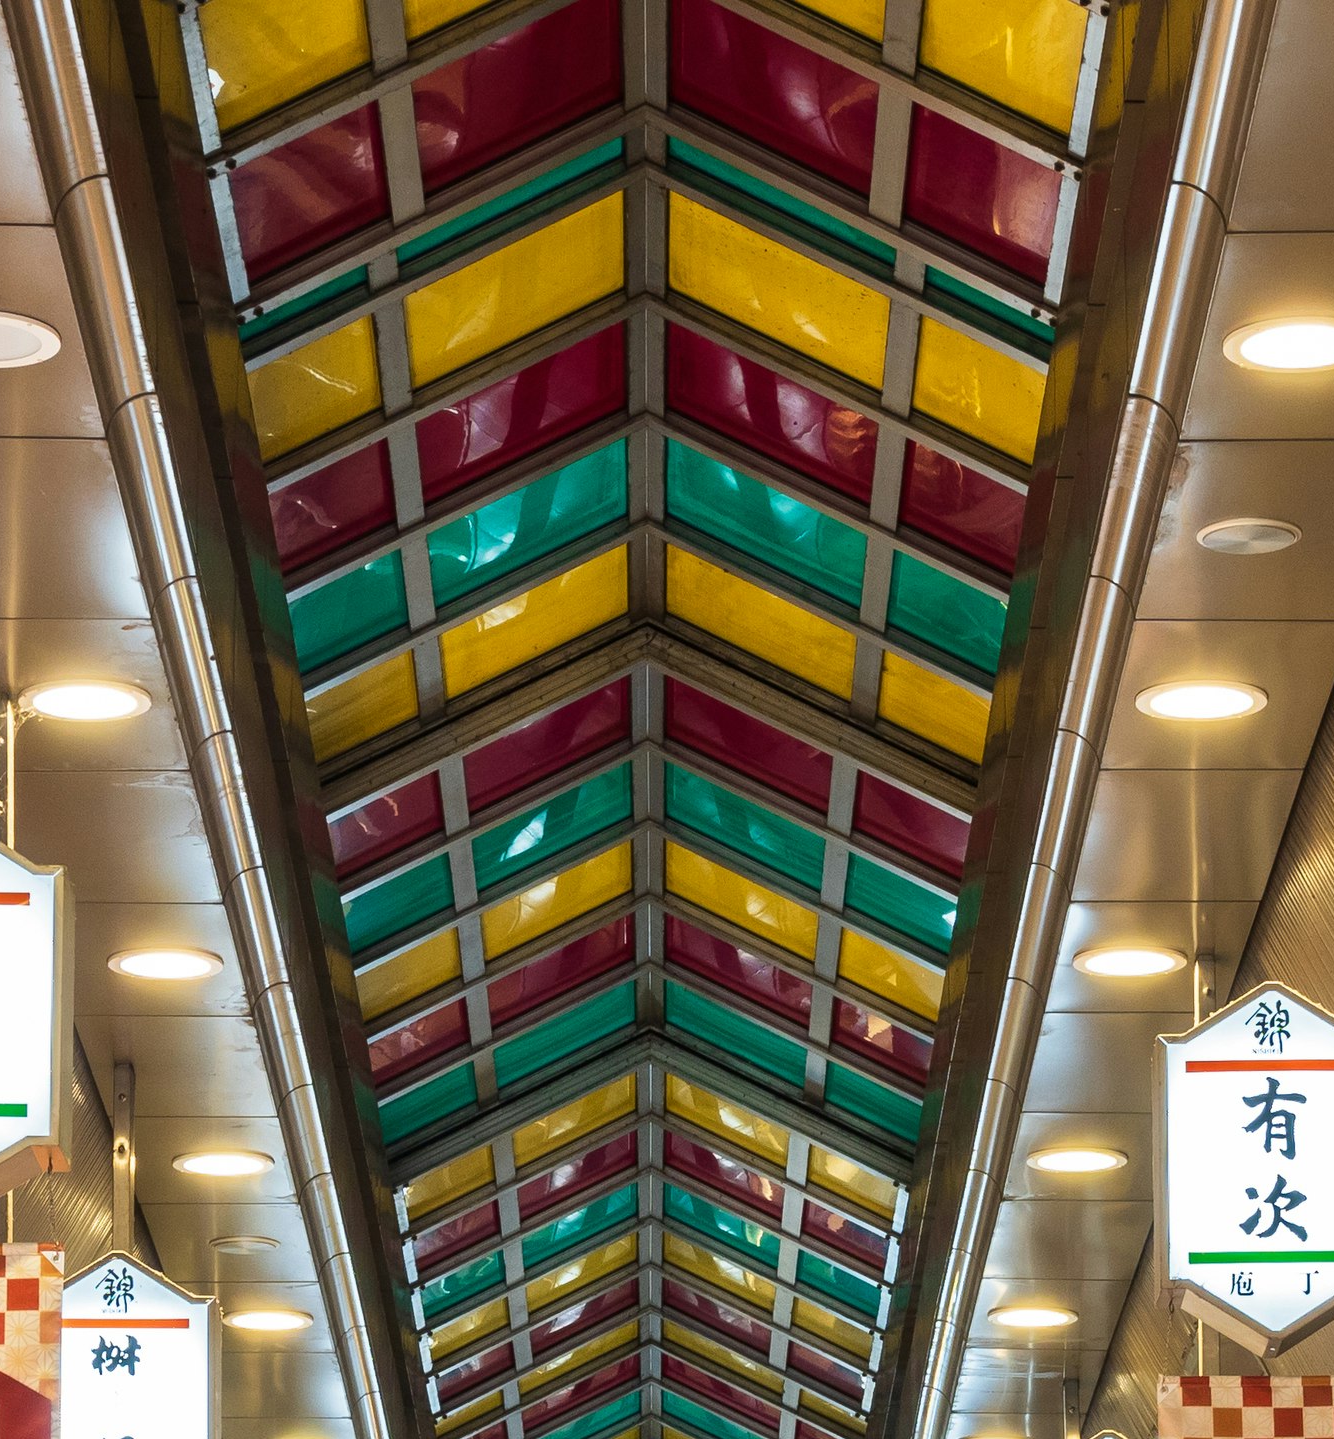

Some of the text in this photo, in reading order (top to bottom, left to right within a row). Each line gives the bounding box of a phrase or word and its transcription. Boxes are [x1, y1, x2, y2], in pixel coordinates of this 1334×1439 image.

[1245, 1000, 1292, 1053] 錦
[1239, 1077, 1307, 1242] 有次
[95, 1267, 136, 1314] 錦
[1230, 1271, 1320, 1296] 庖丁
